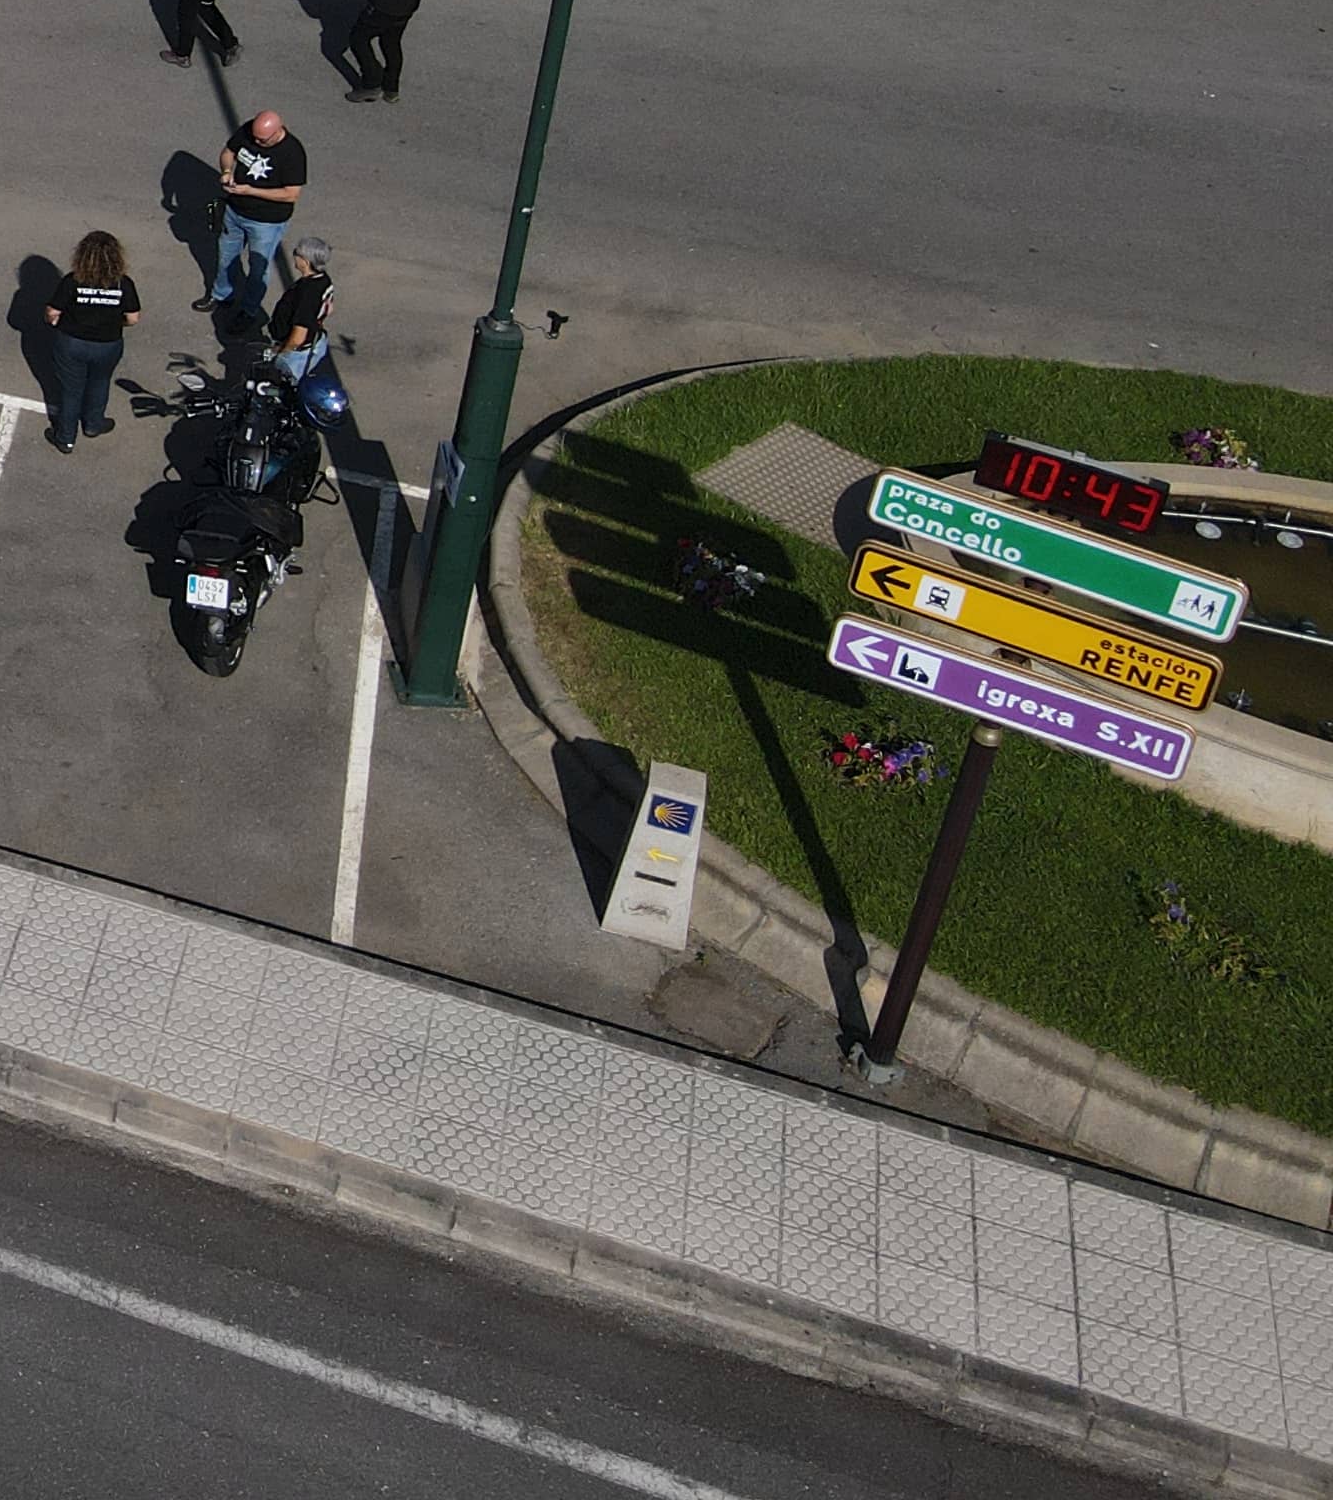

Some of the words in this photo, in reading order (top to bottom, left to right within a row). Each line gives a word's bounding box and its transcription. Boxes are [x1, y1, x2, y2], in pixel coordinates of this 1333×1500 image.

[889, 484, 954, 515] praza
[970, 511, 1001, 530] do
[1003, 451, 1161, 532] 10:43
[884, 502, 1022, 563] Concello
[1080, 649, 1196, 702] RENFE
[1100, 639, 1201, 680] estación
[976, 680, 1075, 728] igrexa
[1096, 721, 1175, 762] S.XII
